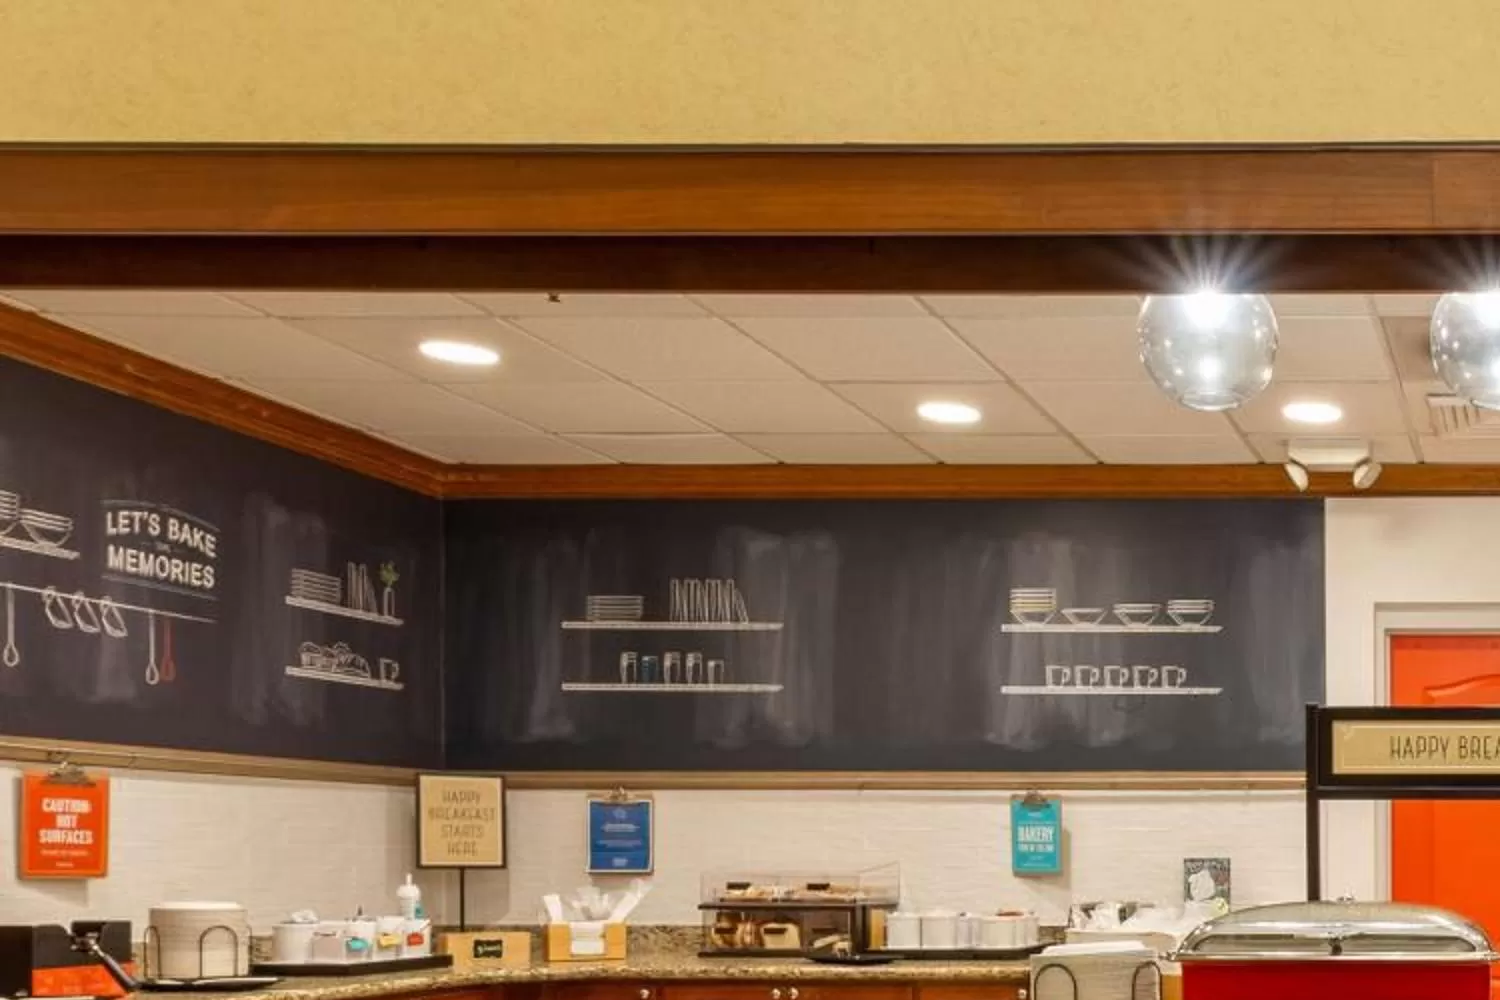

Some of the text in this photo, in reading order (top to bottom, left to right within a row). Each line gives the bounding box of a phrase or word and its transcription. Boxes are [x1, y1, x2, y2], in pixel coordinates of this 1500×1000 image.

[106, 510, 161, 536] LET'S
[167, 516, 217, 558] BAKE
[107, 543, 215, 588] MEMORIES
[1390, 735, 1449, 760] HAPPY
[443, 789, 481, 806] HAPPY
[56, 813, 78, 829] HOT
[441, 823, 485, 838] STARTS
[1018, 825, 1054, 842] BAKERY
